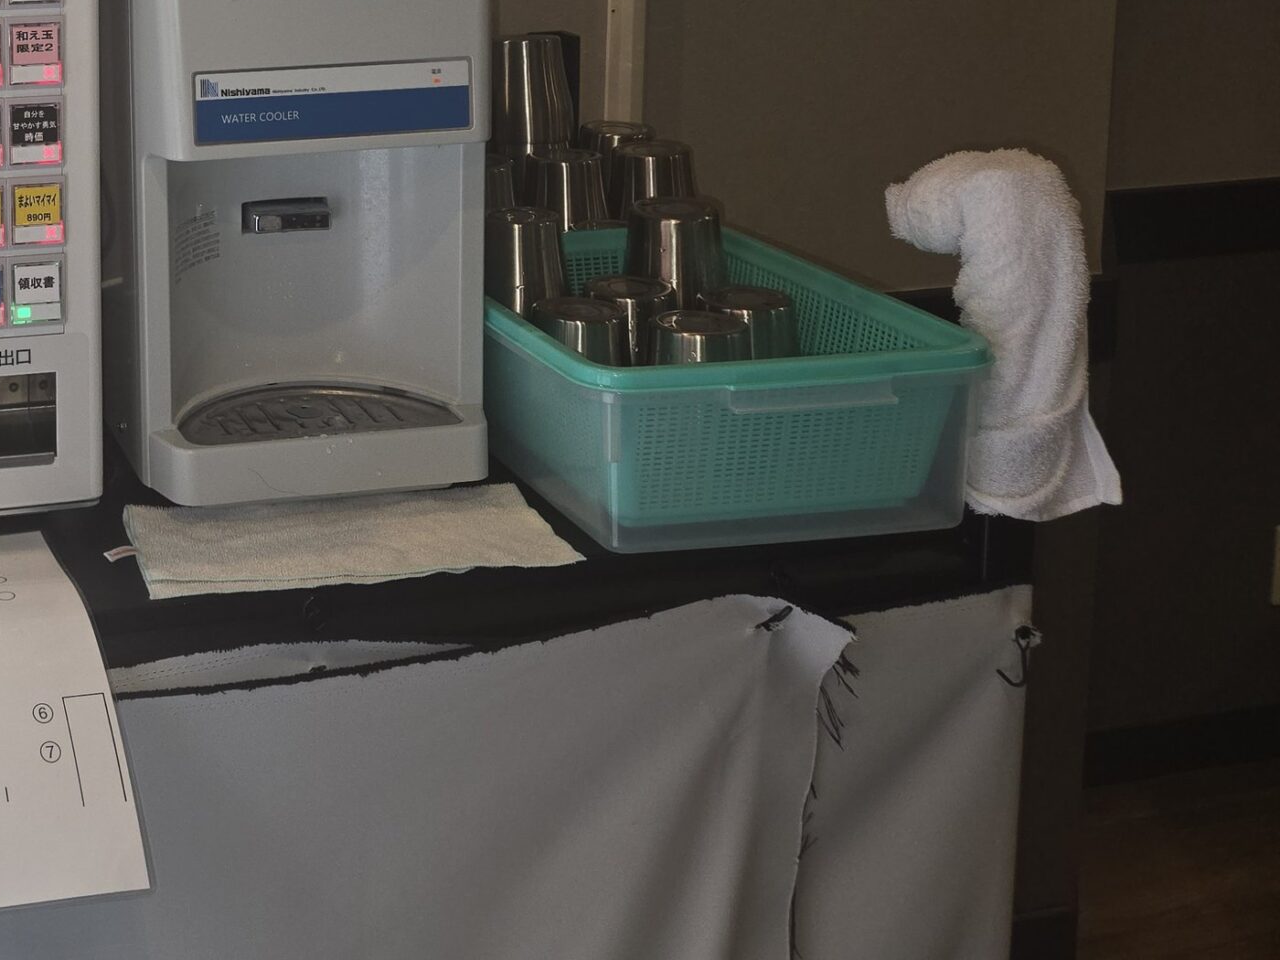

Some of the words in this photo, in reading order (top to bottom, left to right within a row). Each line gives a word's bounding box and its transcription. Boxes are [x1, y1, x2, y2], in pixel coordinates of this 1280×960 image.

[15, 29, 54, 41] 和え玉
[16, 43, 54, 53] 限定2
[220, 88, 270, 97] Nishiyama
[23, 110, 45, 119] 自分を
[221, 113, 257, 124] WATER
[259, 110, 300, 121] COOLER
[24, 132, 44, 142] 時価
[17, 193, 56, 208] まよいマイマイ
[26, 213, 51, 222] 890円
[18, 276, 56, 290] 領収書
